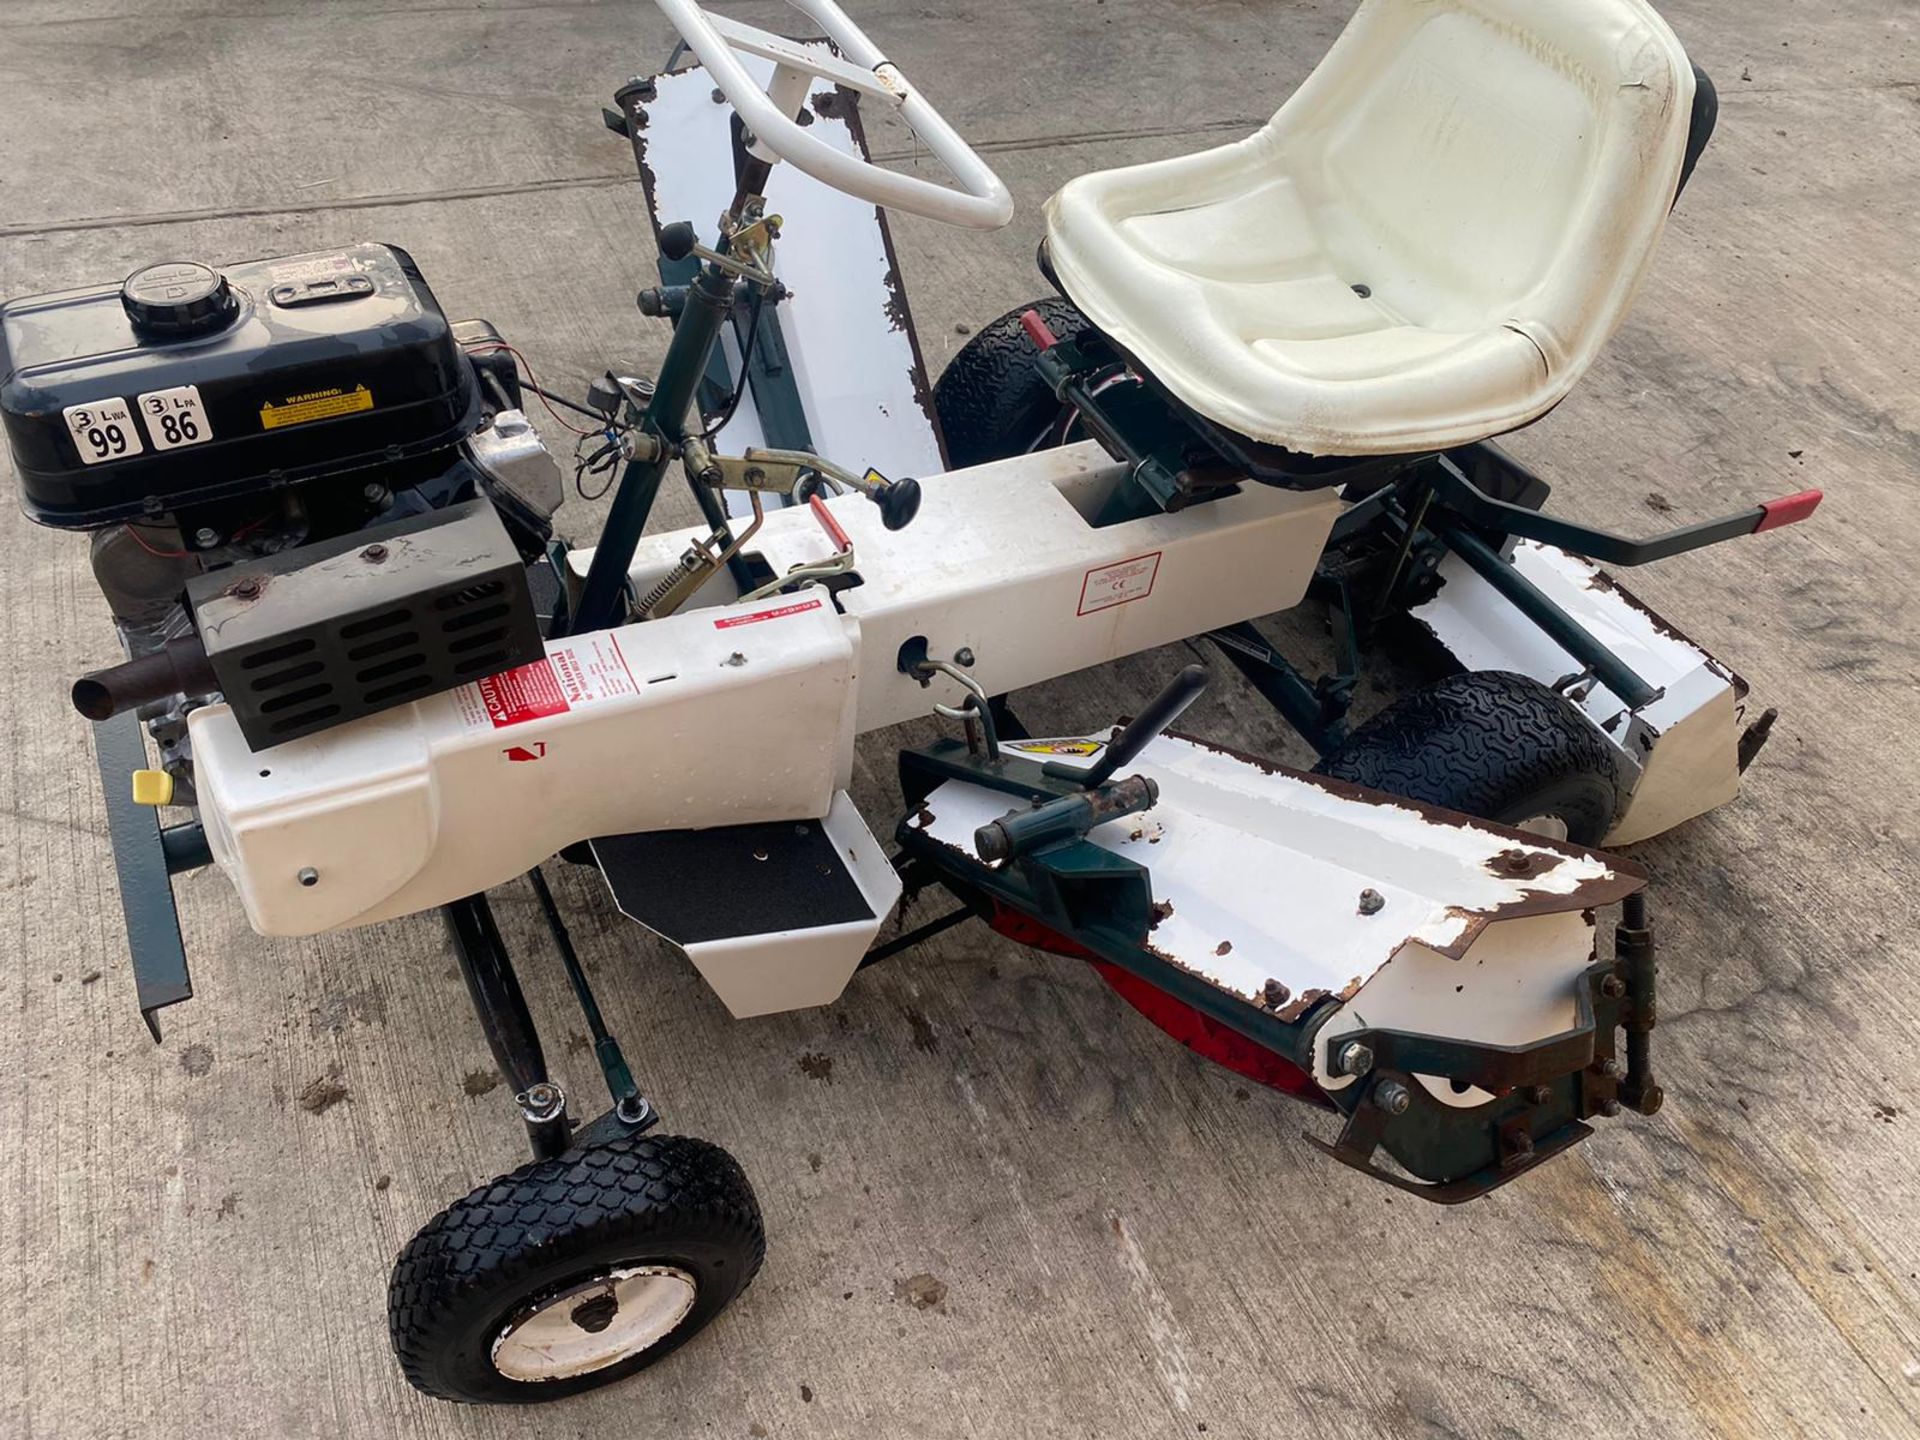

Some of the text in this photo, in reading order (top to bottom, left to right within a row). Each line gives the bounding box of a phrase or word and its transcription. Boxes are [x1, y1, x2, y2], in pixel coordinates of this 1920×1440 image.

[149, 399, 164, 414] 3
[286, 388, 342, 404] WARNING!
[88, 424, 127, 458] 99
[161, 411, 198, 444] 86
[550, 651, 584, 703] National
[478, 677, 502, 712] CAUTI
